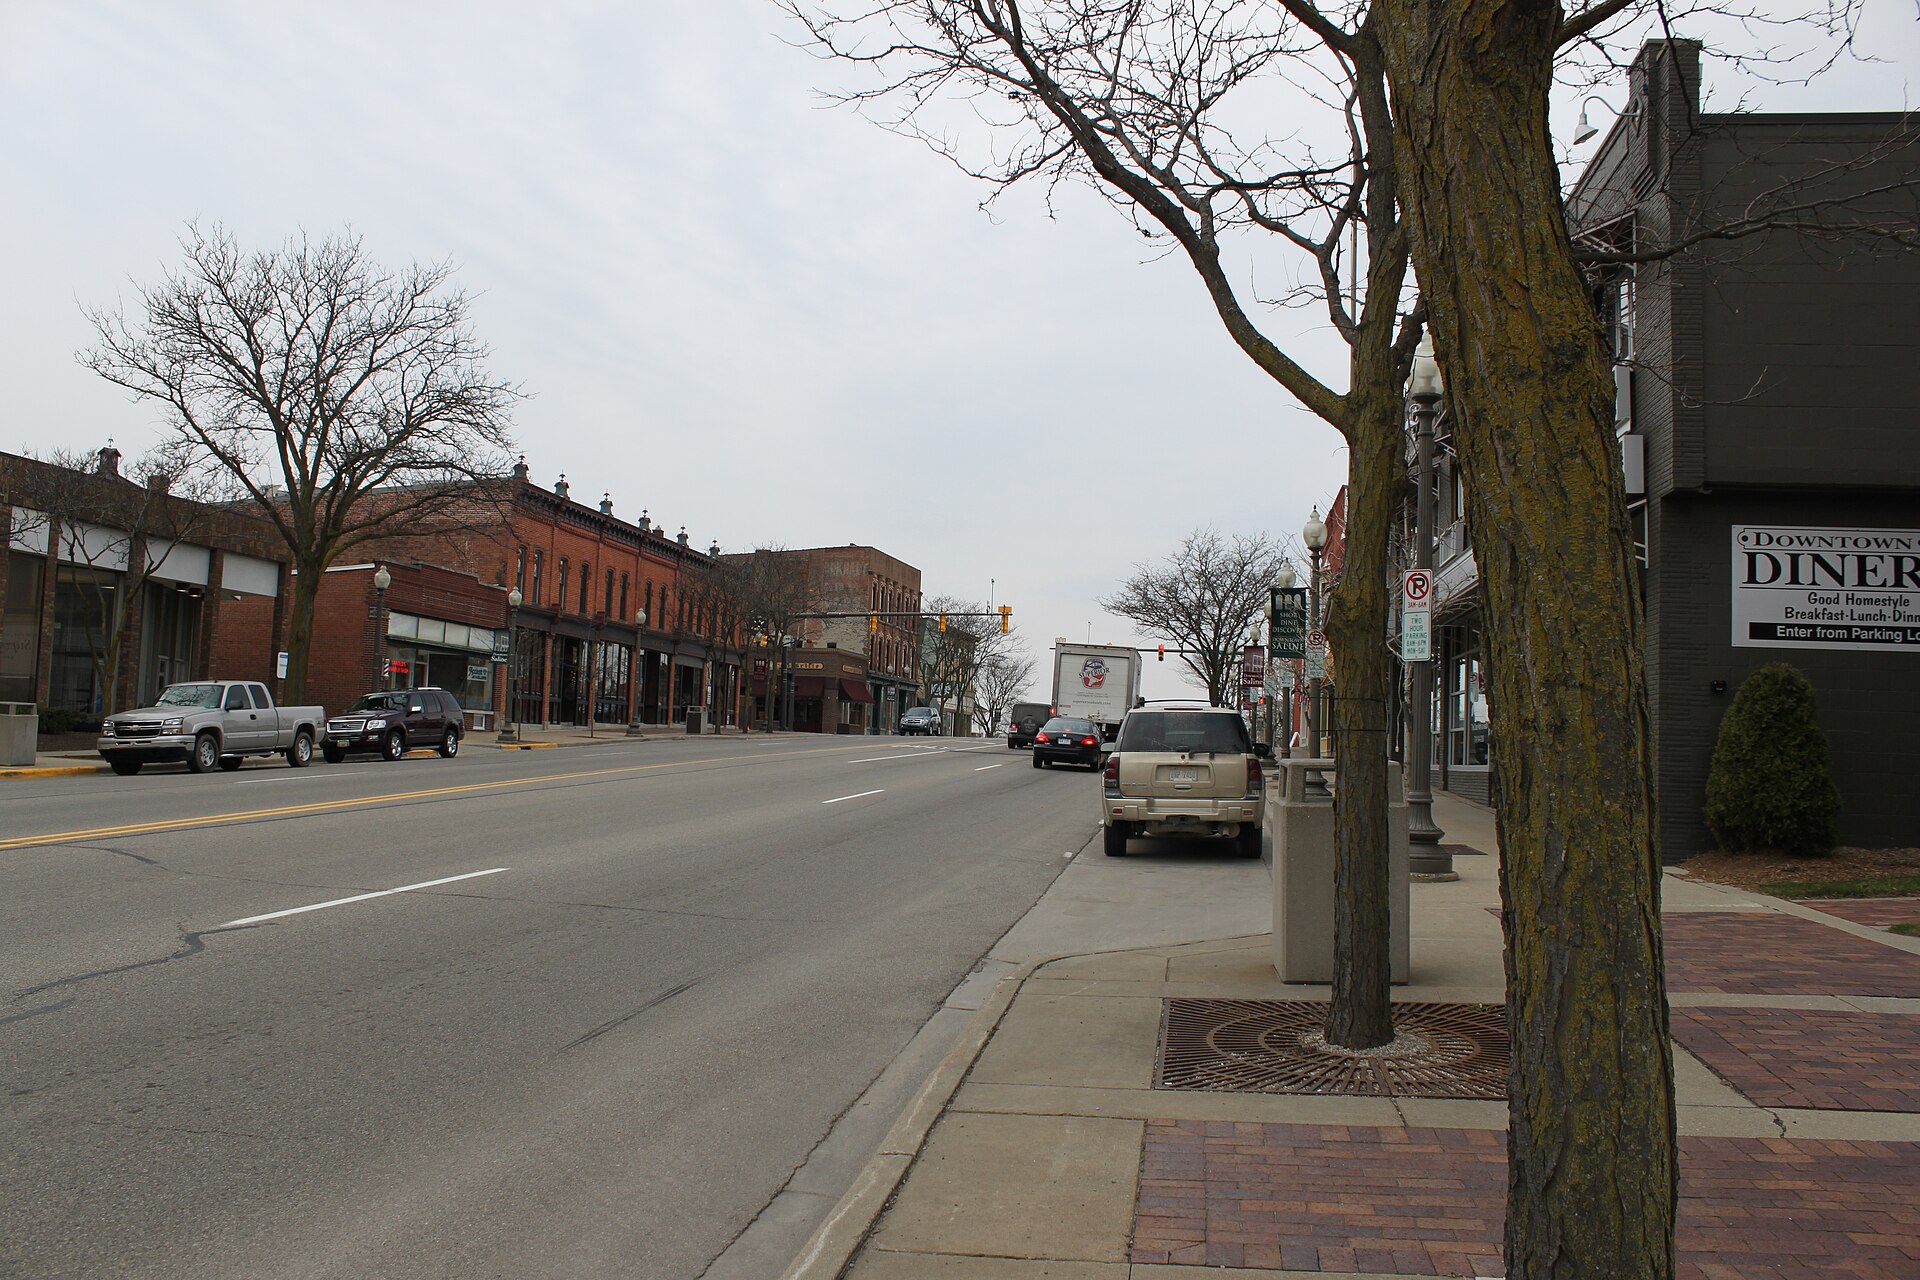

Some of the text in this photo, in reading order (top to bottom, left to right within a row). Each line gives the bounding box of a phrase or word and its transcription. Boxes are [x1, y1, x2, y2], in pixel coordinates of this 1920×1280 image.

[1753, 531, 1912, 550] DOWNTOWN
[1741, 551, 1920, 588] DINER
[1807, 591, 1910, 609] Good Homestyle
[1777, 626, 1813, 638] Enter
[1816, 627, 1847, 639] from
[1852, 628, 1903, 643] Parking
[1271, 642, 1304, 651] SALINE
[1079, 667, 1110, 678] SUPERIOR
[1243, 677, 1263, 685] Saline
